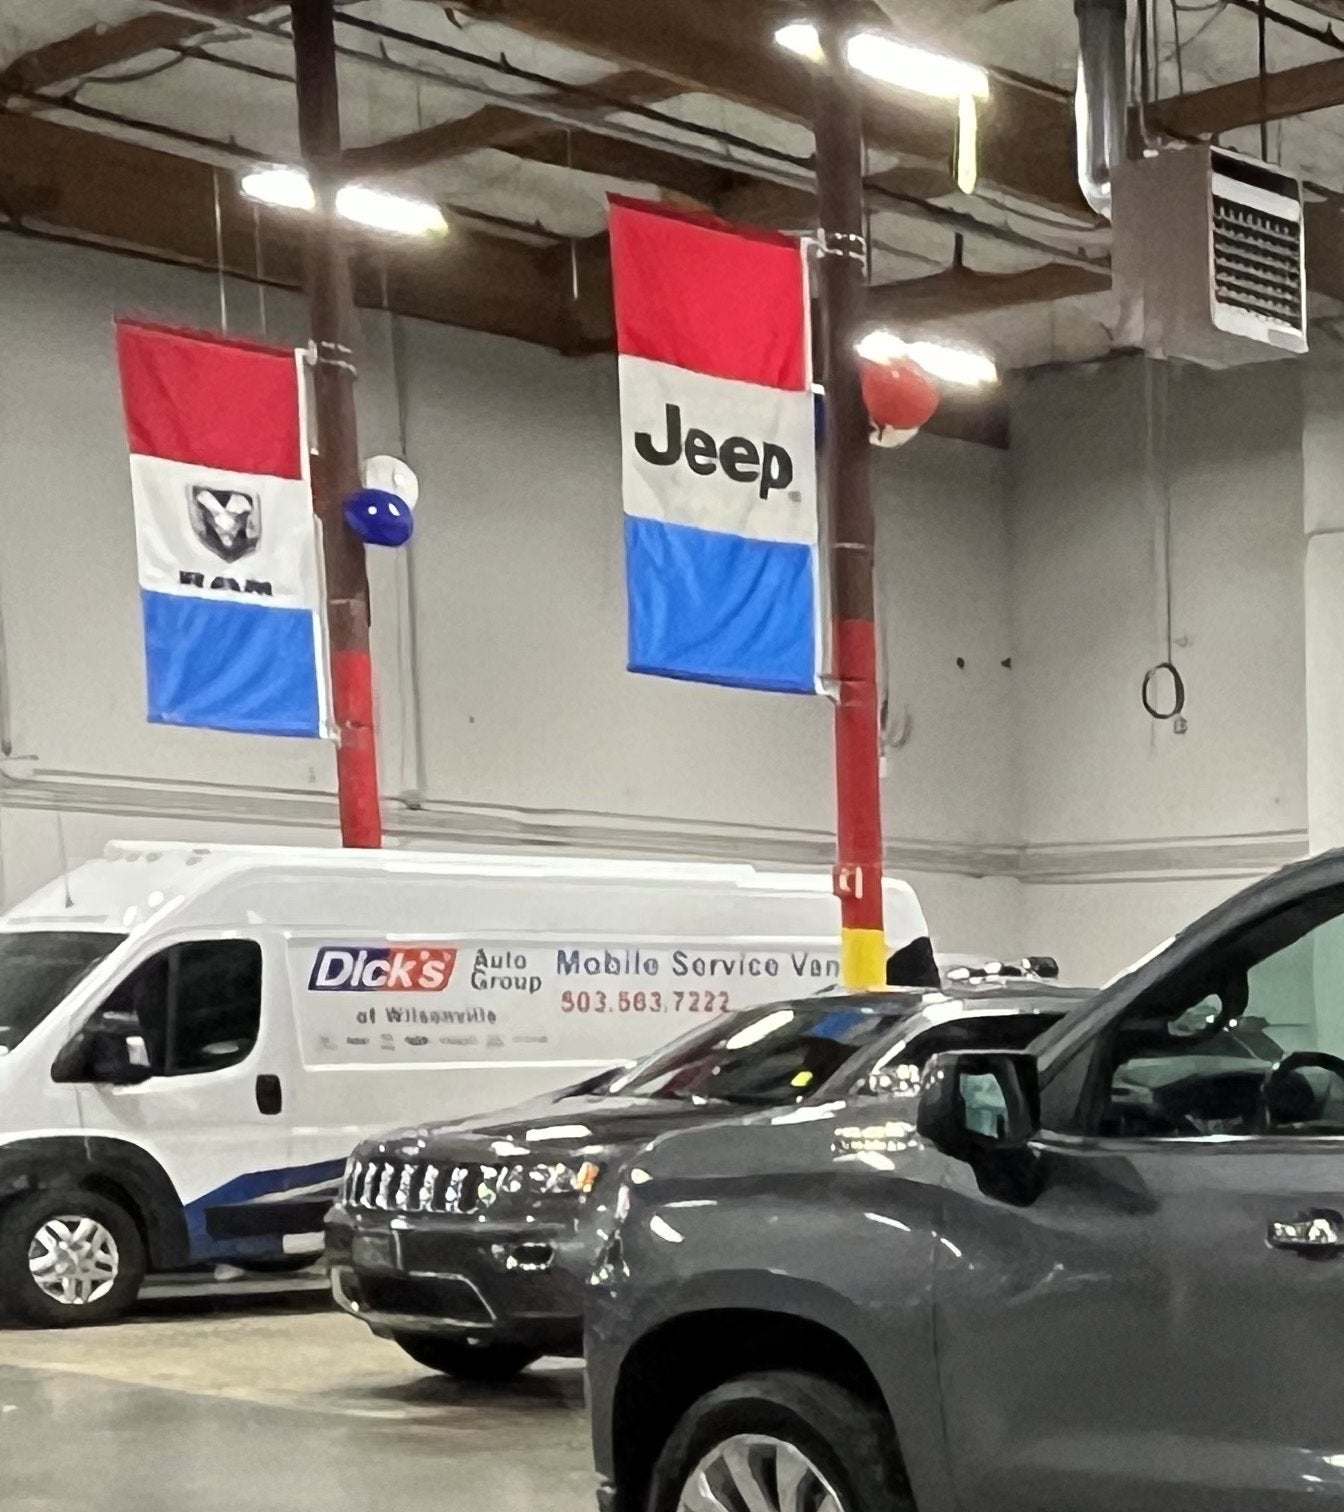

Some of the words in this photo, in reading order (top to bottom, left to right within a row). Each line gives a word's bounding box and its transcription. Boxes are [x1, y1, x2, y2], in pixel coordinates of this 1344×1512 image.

[634, 402, 794, 501] Jeep
[314, 949, 447, 990] Dick's
[472, 947, 528, 971] Auto
[556, 949, 659, 976] Mobile
[671, 950, 779, 977] Service
[790, 951, 840, 978] Van
[470, 970, 543, 994] Group
